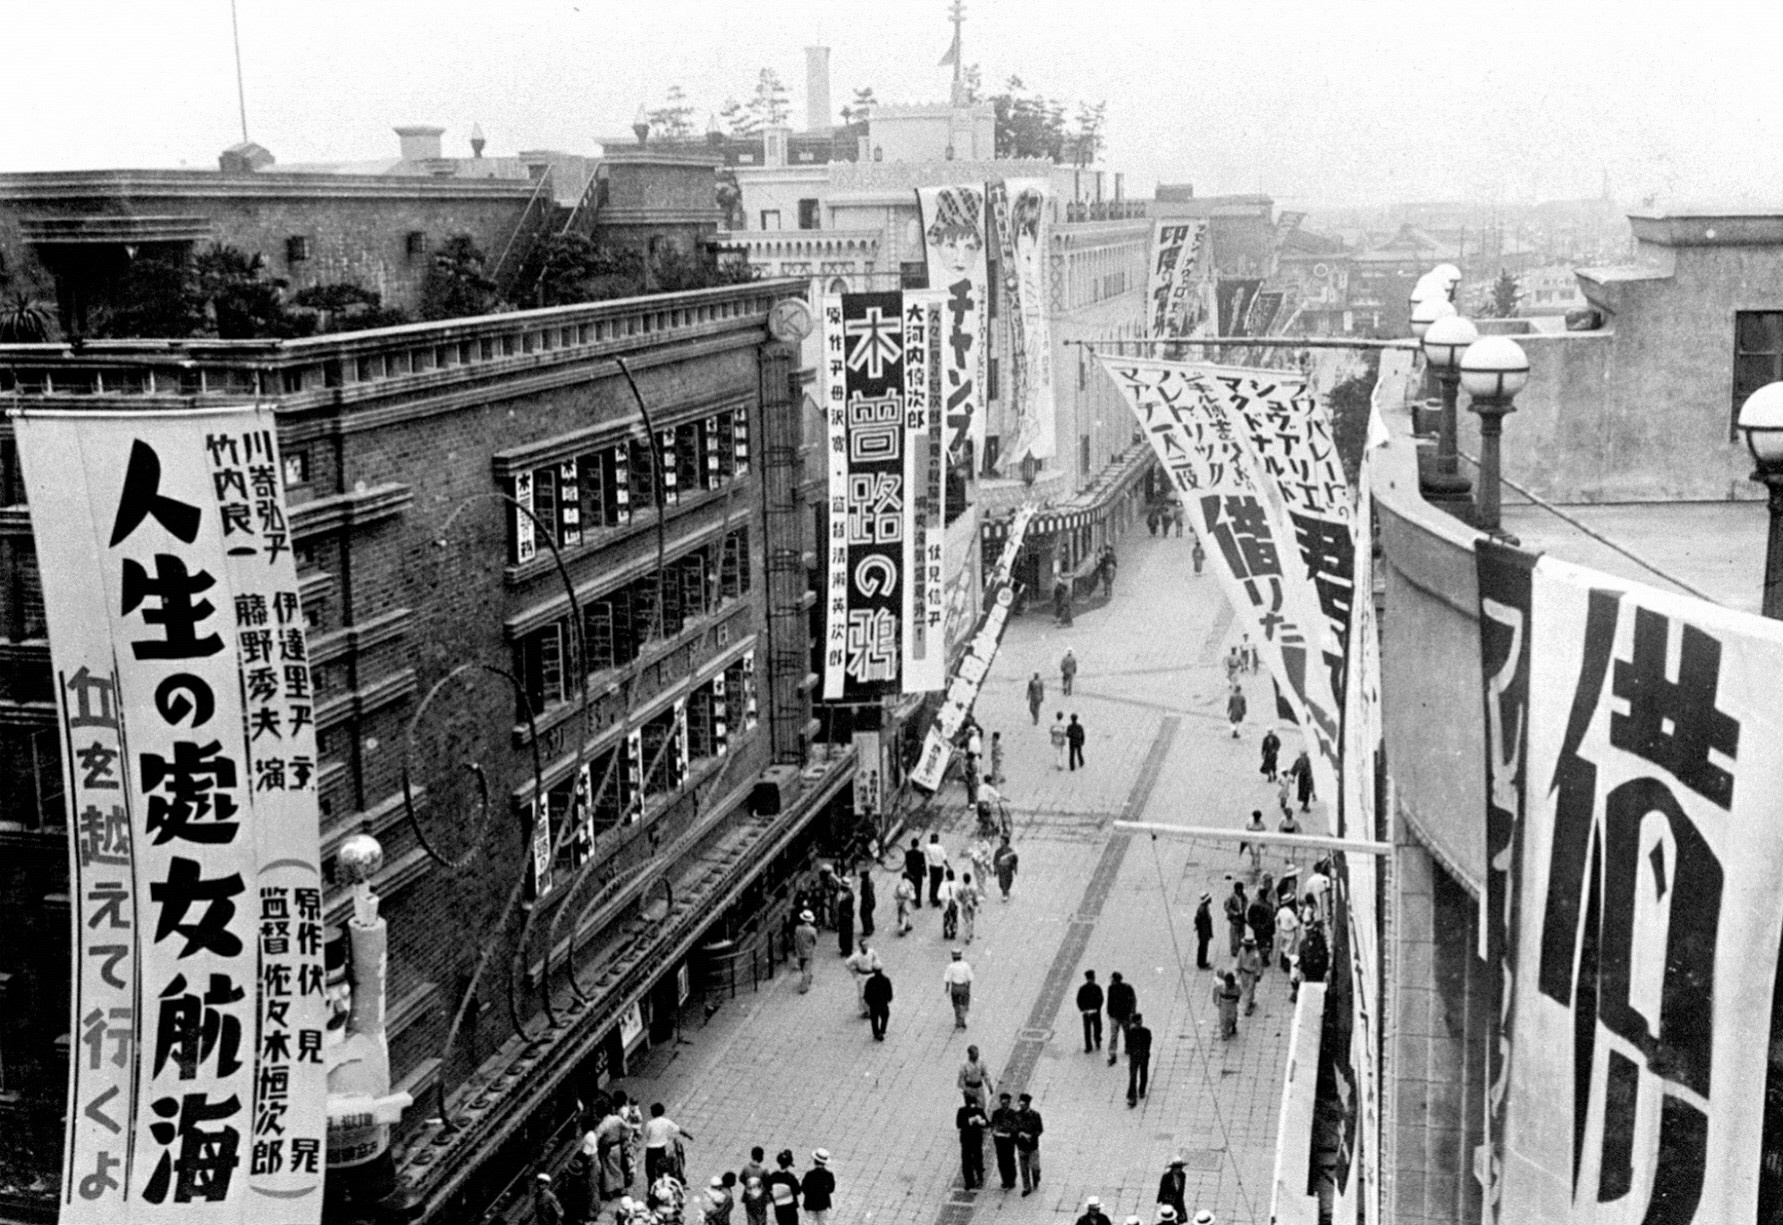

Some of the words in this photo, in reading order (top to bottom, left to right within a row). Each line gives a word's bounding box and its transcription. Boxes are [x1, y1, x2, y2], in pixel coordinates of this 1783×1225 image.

[206, 433, 258, 556] 竹内良一
[233, 592, 283, 742] 藤野秀夫
[273, 590, 314, 738] 伊達里子
